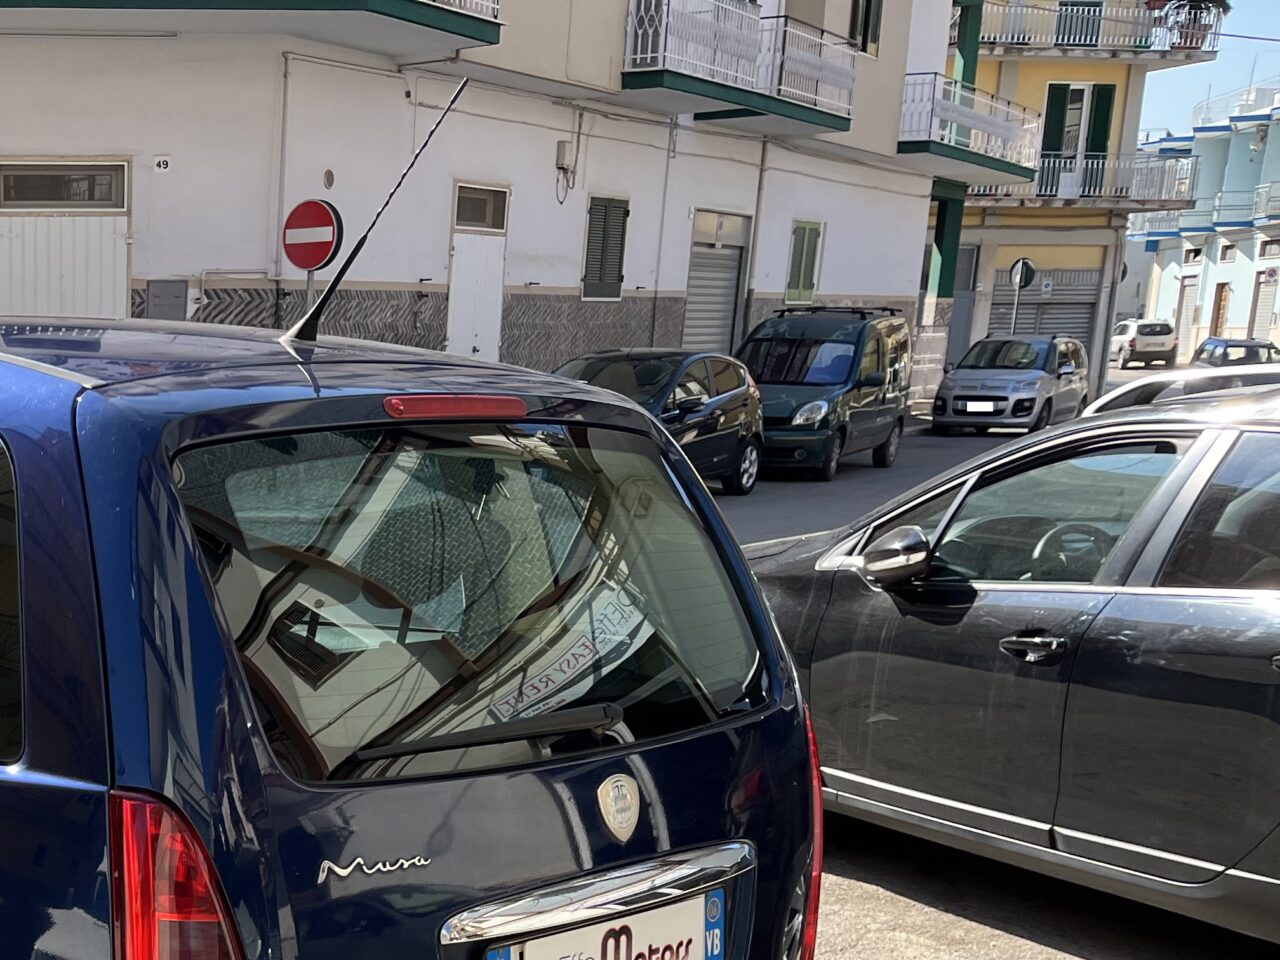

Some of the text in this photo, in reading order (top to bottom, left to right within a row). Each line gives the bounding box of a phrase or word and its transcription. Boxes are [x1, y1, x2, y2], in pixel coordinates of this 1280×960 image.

[156, 159, 169, 170] 49
[317, 856, 432, 884] Musa
[705, 928, 721, 958] VB
